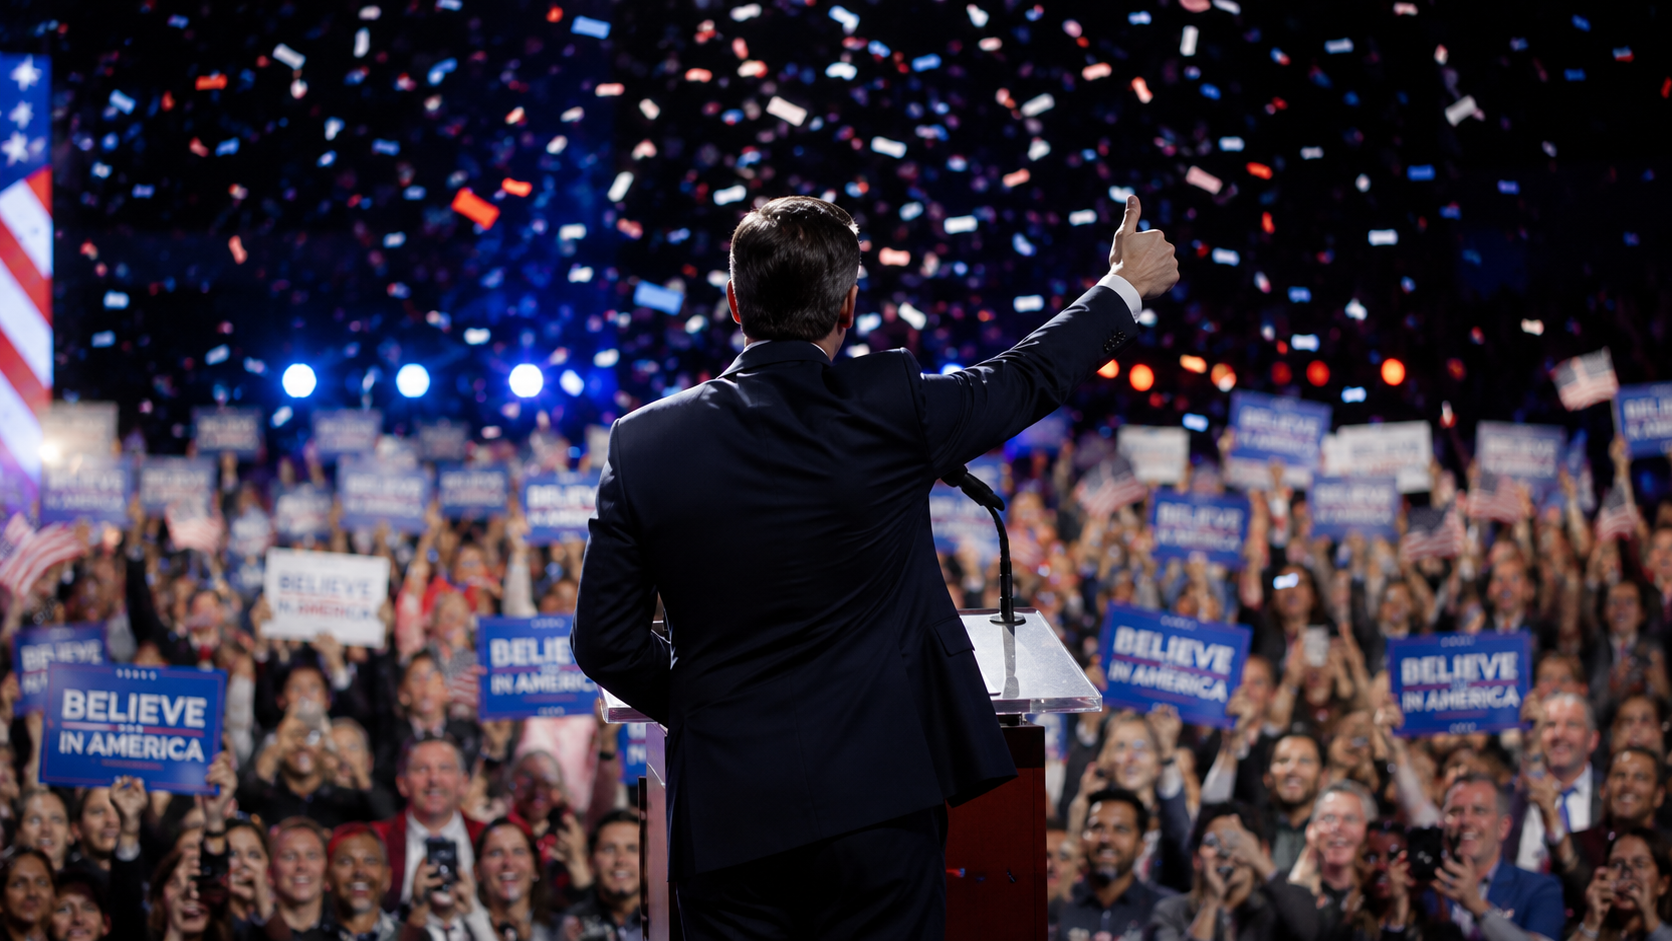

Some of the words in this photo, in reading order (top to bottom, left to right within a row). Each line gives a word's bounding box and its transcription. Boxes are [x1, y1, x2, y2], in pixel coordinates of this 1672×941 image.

[490, 637, 572, 668] BELIE
[1113, 625, 1235, 675] BELIEVE
[490, 672, 514, 695] IN
[515, 671, 598, 695] AMERIC
[1108, 659, 1133, 683] IN
[1131, 663, 1229, 703] AMERICA
[1401, 651, 1519, 686] BELIEVE
[61, 688, 208, 728] BELIEVE
[1401, 690, 1425, 713] IN
[1425, 684, 1521, 712] AMERICA
[58, 730, 84, 755] IN
[86, 731, 205, 763] AMERICA
